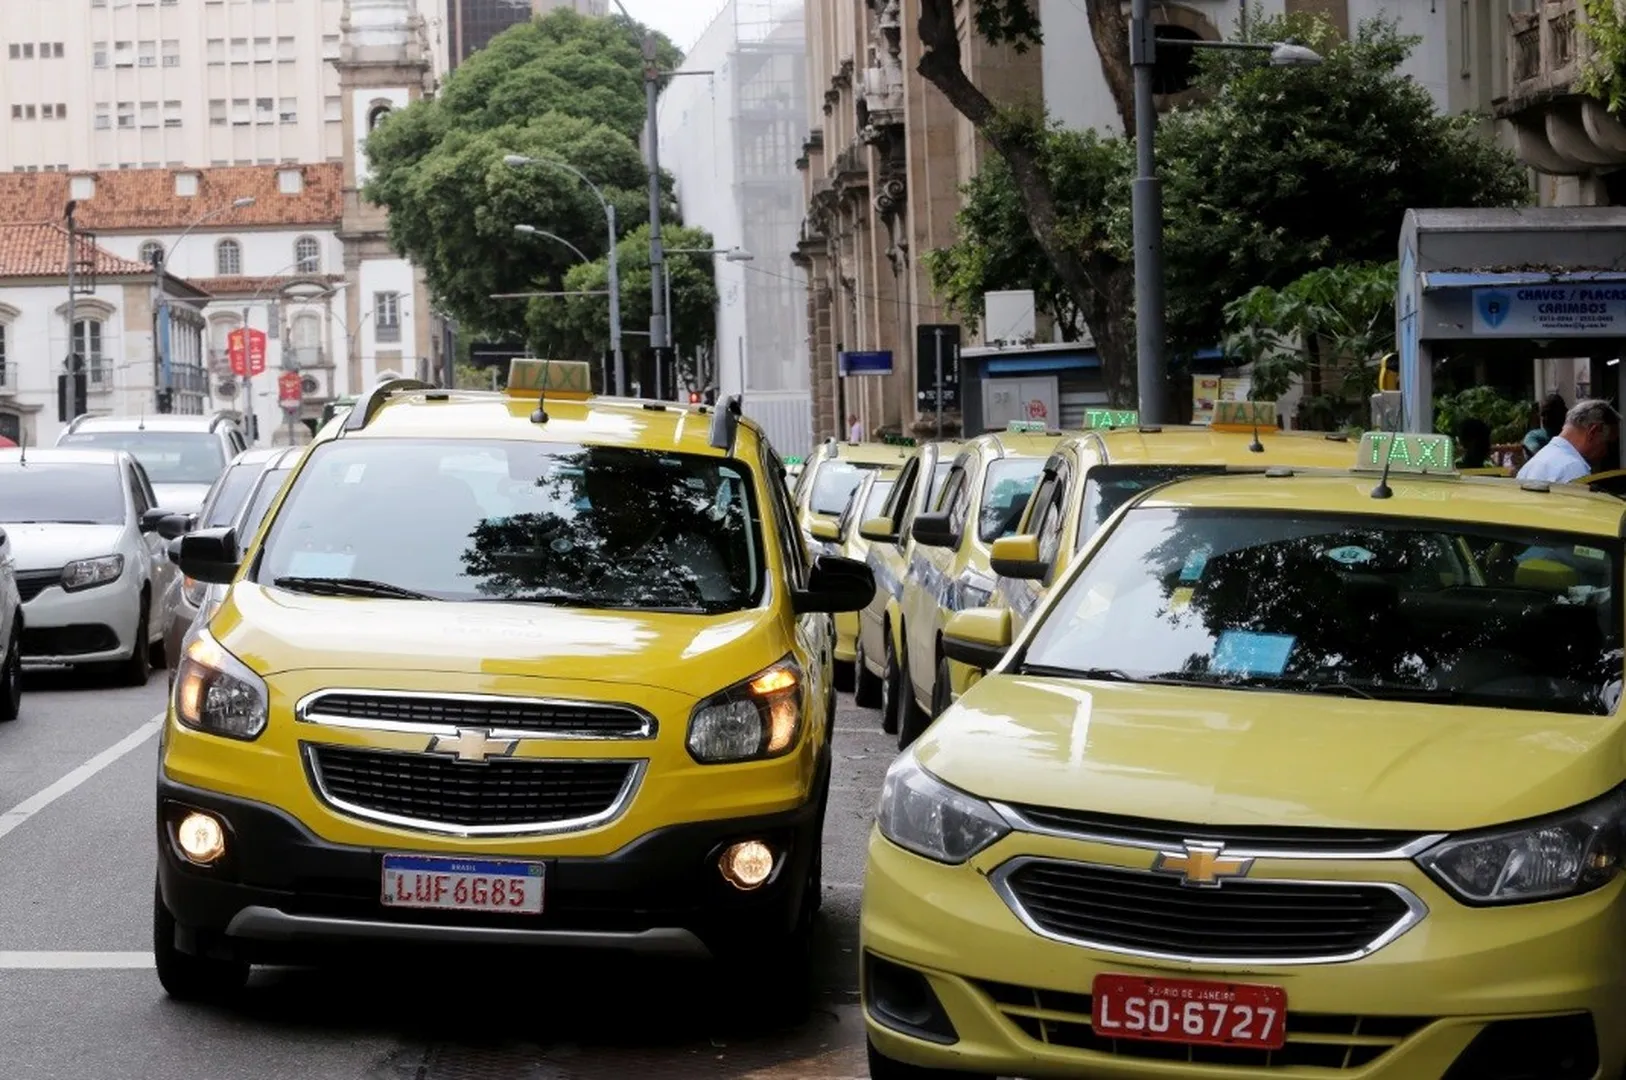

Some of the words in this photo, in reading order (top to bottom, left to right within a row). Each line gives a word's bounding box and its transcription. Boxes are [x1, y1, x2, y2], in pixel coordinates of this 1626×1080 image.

[1517, 290, 1566, 301] CHAVES
[1569, 290, 1576, 301] /
[1538, 303, 1607, 314] CARIMBOS
[515, 362, 586, 390] TAXI
[1087, 411, 1137, 427] TAXI
[1216, 402, 1274, 424] TAXI
[1367, 435, 1449, 467] TAXI
[451, 864, 476, 872] BRASIL
[396, 874, 525, 906] LUF6G85
[1182, 989, 1193, 999] DE
[1197, 991, 1235, 1001] JANEIRO
